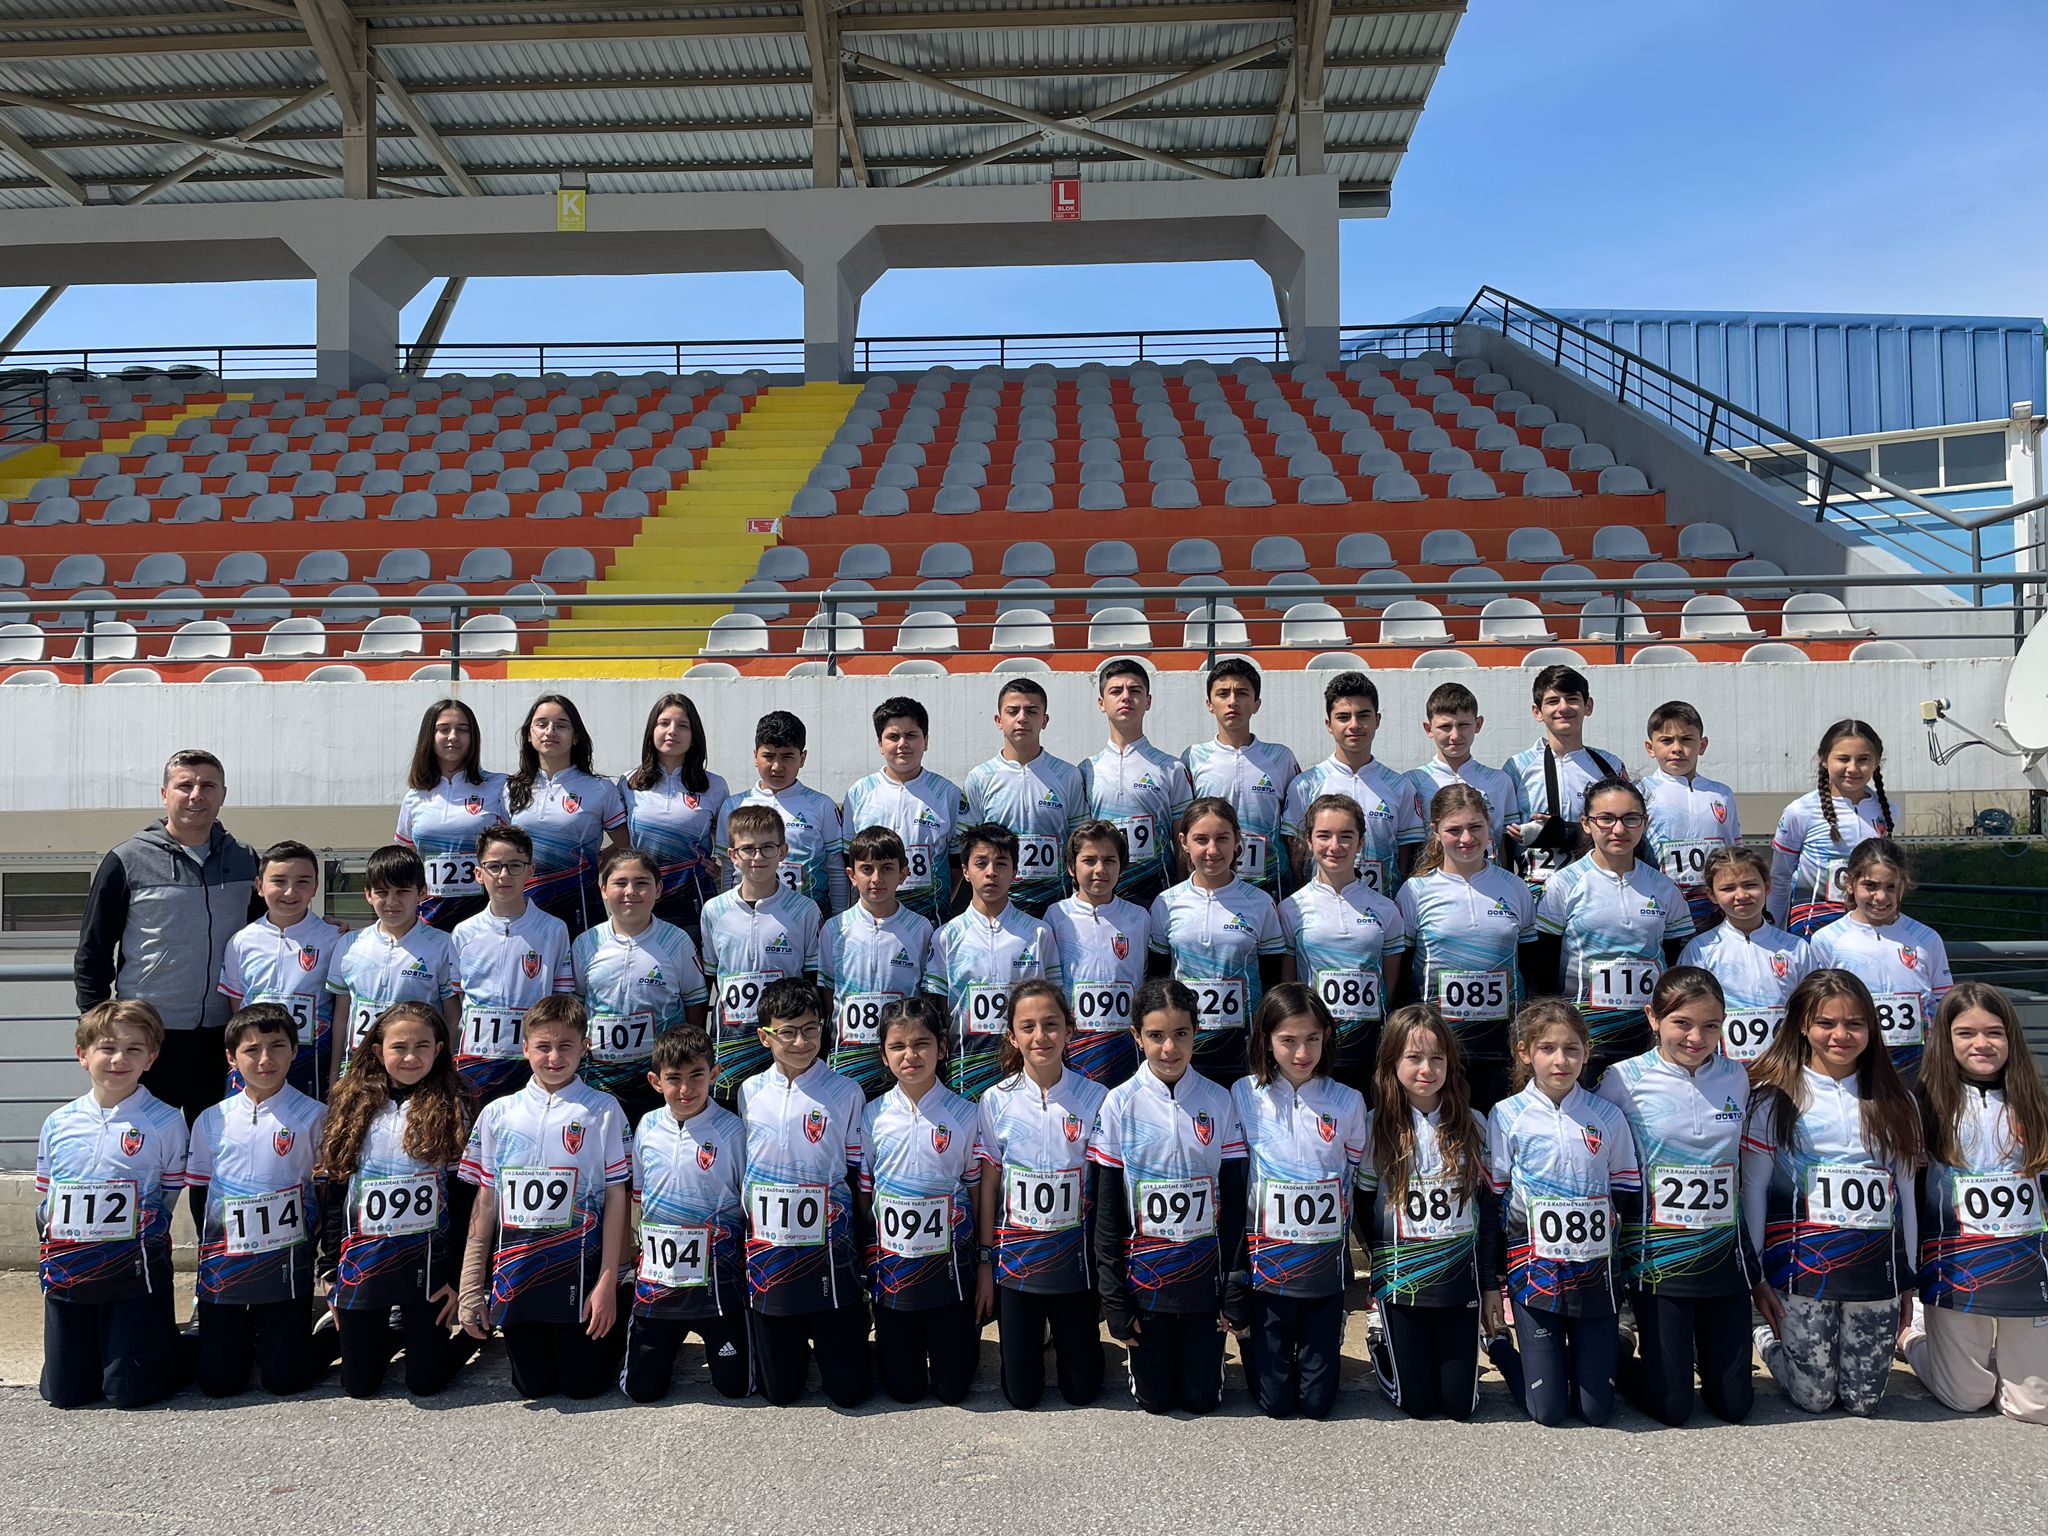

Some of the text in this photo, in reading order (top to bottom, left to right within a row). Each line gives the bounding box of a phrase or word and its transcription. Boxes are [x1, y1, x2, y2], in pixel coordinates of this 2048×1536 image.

[563, 194, 581, 216] K
[1059, 183, 1074, 204] L
[752, 520, 758, 529] L
[1024, 844, 1054, 867] 20
[1671, 848, 1705, 872] 10
[430, 861, 475, 884] 123
[401, 970, 433, 979] DOSTUM
[1600, 969, 1654, 994] 116
[1079, 992, 1130, 1017] 090
[1324, 979, 1375, 1006] 086
[1446, 981, 1502, 1007] 085
[847, 1003, 879, 1029] 08
[974, 993, 1008, 1020] 09
[1876, 1004, 1915, 1030] 83
[473, 1018, 521, 1044] 111
[598, 1022, 647, 1050] 107
[366, 1186, 433, 1221] 098
[508, 1180, 568, 1211] 109
[1017, 1181, 1070, 1213] 101
[1147, 1190, 1207, 1224] 097
[1661, 1178, 1729, 1210] 225
[1817, 1178, 1886, 1212] 100
[1964, 1183, 2034, 1219] 099
[62, 1193, 127, 1224] 112
[233, 1200, 298, 1238] 114
[759, 1196, 818, 1228] 110
[1274, 1193, 1336, 1226] 102
[885, 1207, 943, 1239] 094
[1540, 1209, 1606, 1244] 088
[648, 1236, 700, 1269] 104
